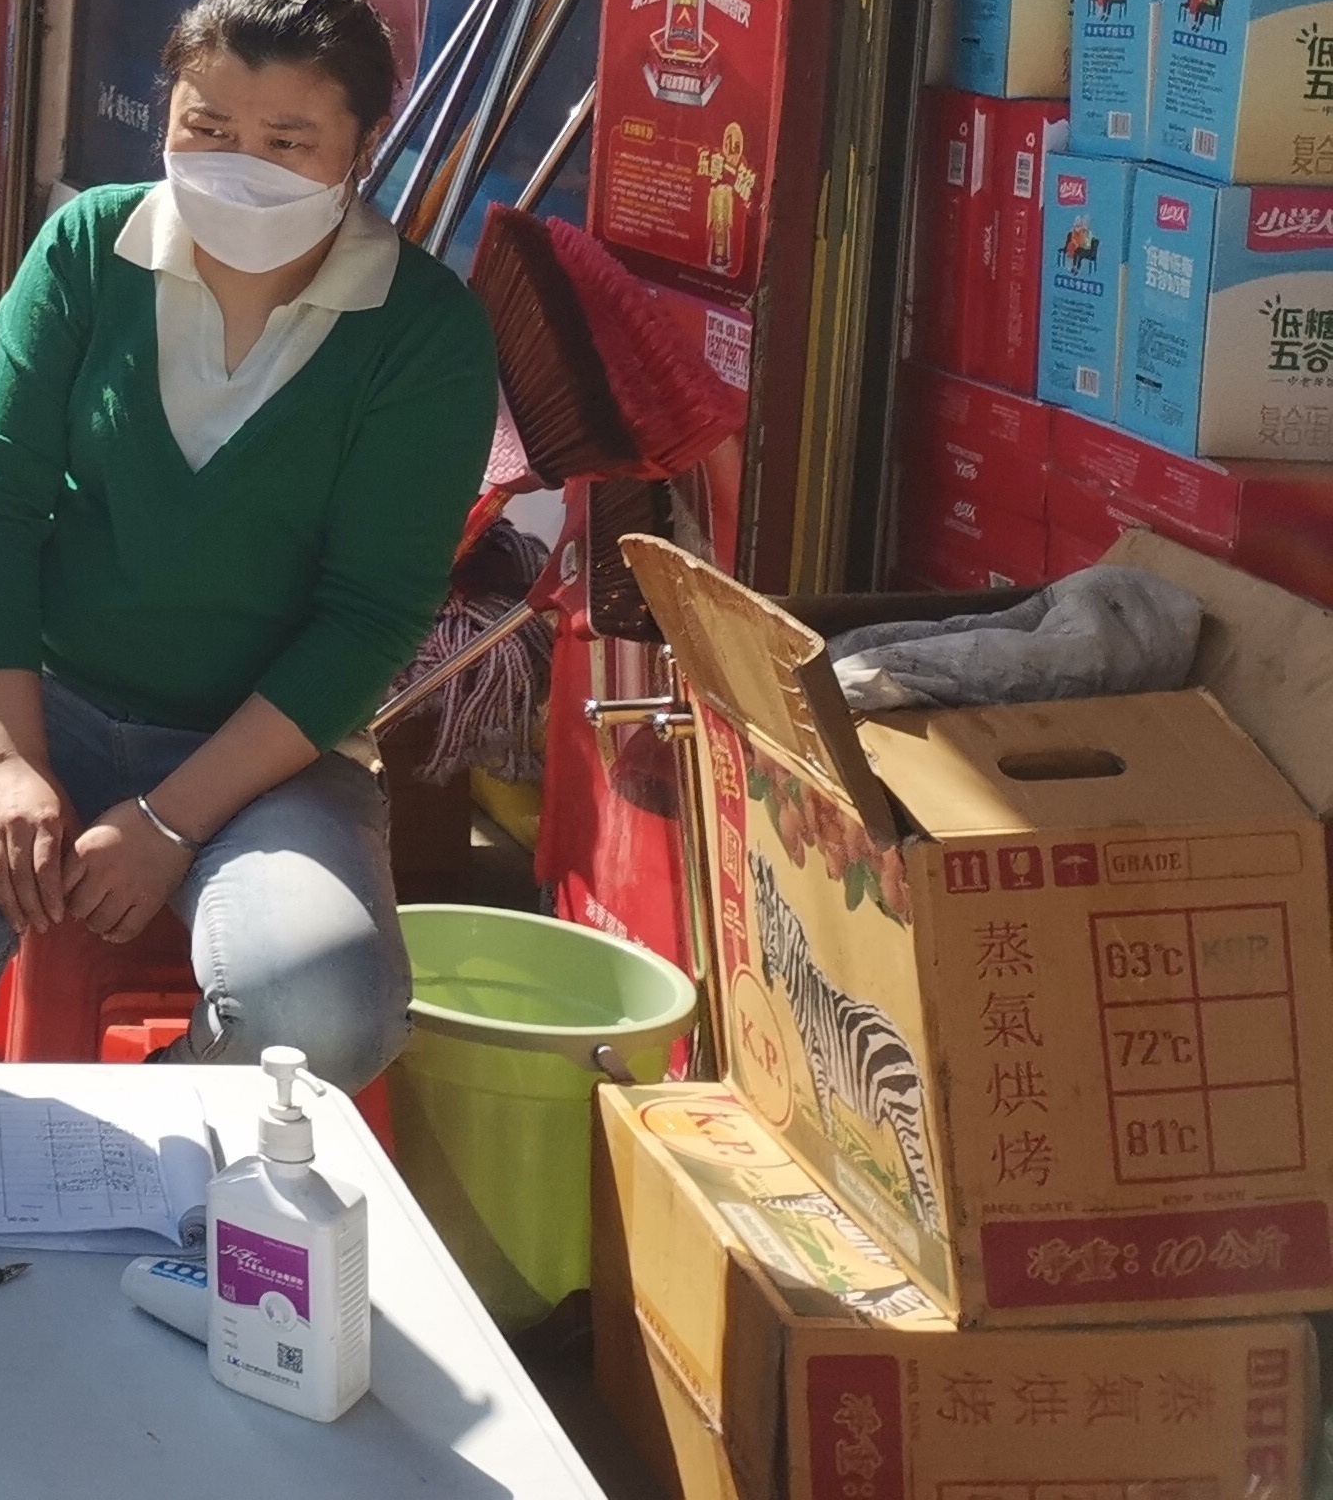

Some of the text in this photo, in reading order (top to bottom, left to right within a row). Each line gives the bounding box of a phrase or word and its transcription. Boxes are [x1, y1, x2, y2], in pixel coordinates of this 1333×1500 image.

[1271, 306, 1333, 340] 低糖
[1268, 340, 1333, 373] 五谷
[1111, 852, 1182, 874] GRADE
[973, 920, 1052, 1187] 蒸氣烘烤
